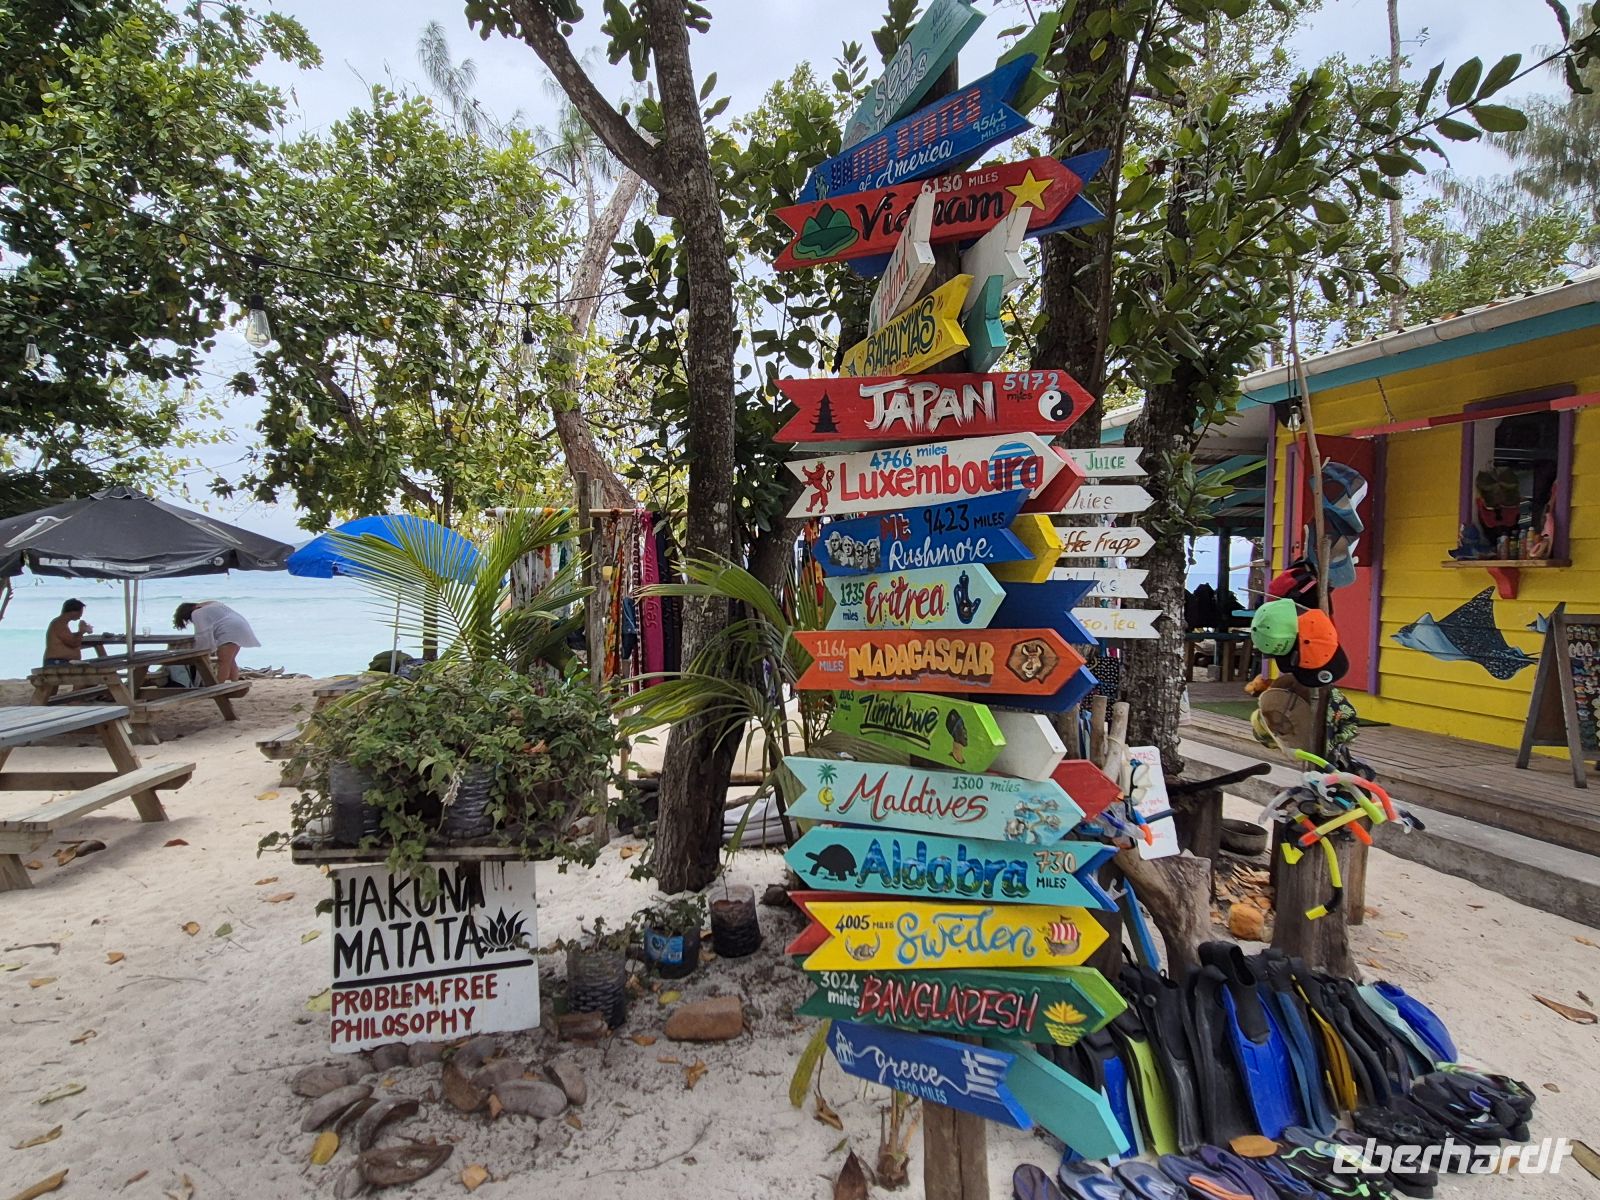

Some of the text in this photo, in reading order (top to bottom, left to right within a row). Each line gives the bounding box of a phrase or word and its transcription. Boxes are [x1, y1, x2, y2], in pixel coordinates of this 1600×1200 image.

[874, 40, 913, 118] Sea
[972, 107, 1007, 132] 9541
[981, 120, 1007, 141] MILES
[831, 87, 982, 190] UNITED STATES
[858, 138, 953, 192] of America
[968, 171, 1000, 187] MILES
[856, 191, 1005, 242] Vienam
[863, 295, 936, 377] BAHAMAS
[859, 372, 1060, 434] JAPAN 5972
[1007, 390, 1034, 402] miles
[916, 444, 948, 457] miles
[923, 504, 1006, 536] 9423 MILES
[1094, 531, 1141, 554] Frapp
[864, 575, 946, 625] Eritrea
[842, 608, 859, 621] miles
[1110, 611, 1137, 630] Tea
[816, 639, 848, 659] 1164
[849, 638, 995, 679] MADAGASCAR
[818, 660, 845, 672] MILES
[858, 693, 940, 737] Zimbabwe
[952, 775, 1021, 793] 1300 miles
[838, 772, 988, 823] Maldives
[856, 838, 1030, 899] Aldabra
[1034, 850, 1078, 874] 730
[1036, 876, 1067, 889] MILES
[835, 914, 870, 933] 4005
[896, 907, 1036, 965] Sweden
[333, 914, 487, 979] MATATA
[820, 971, 860, 990] 3024
[828, 989, 860, 1009] miles
[857, 975, 1039, 1034] BANGLADESH
[331, 1006, 476, 1043] PHILOSOPHY
[920, 1085, 948, 1105] MILES
